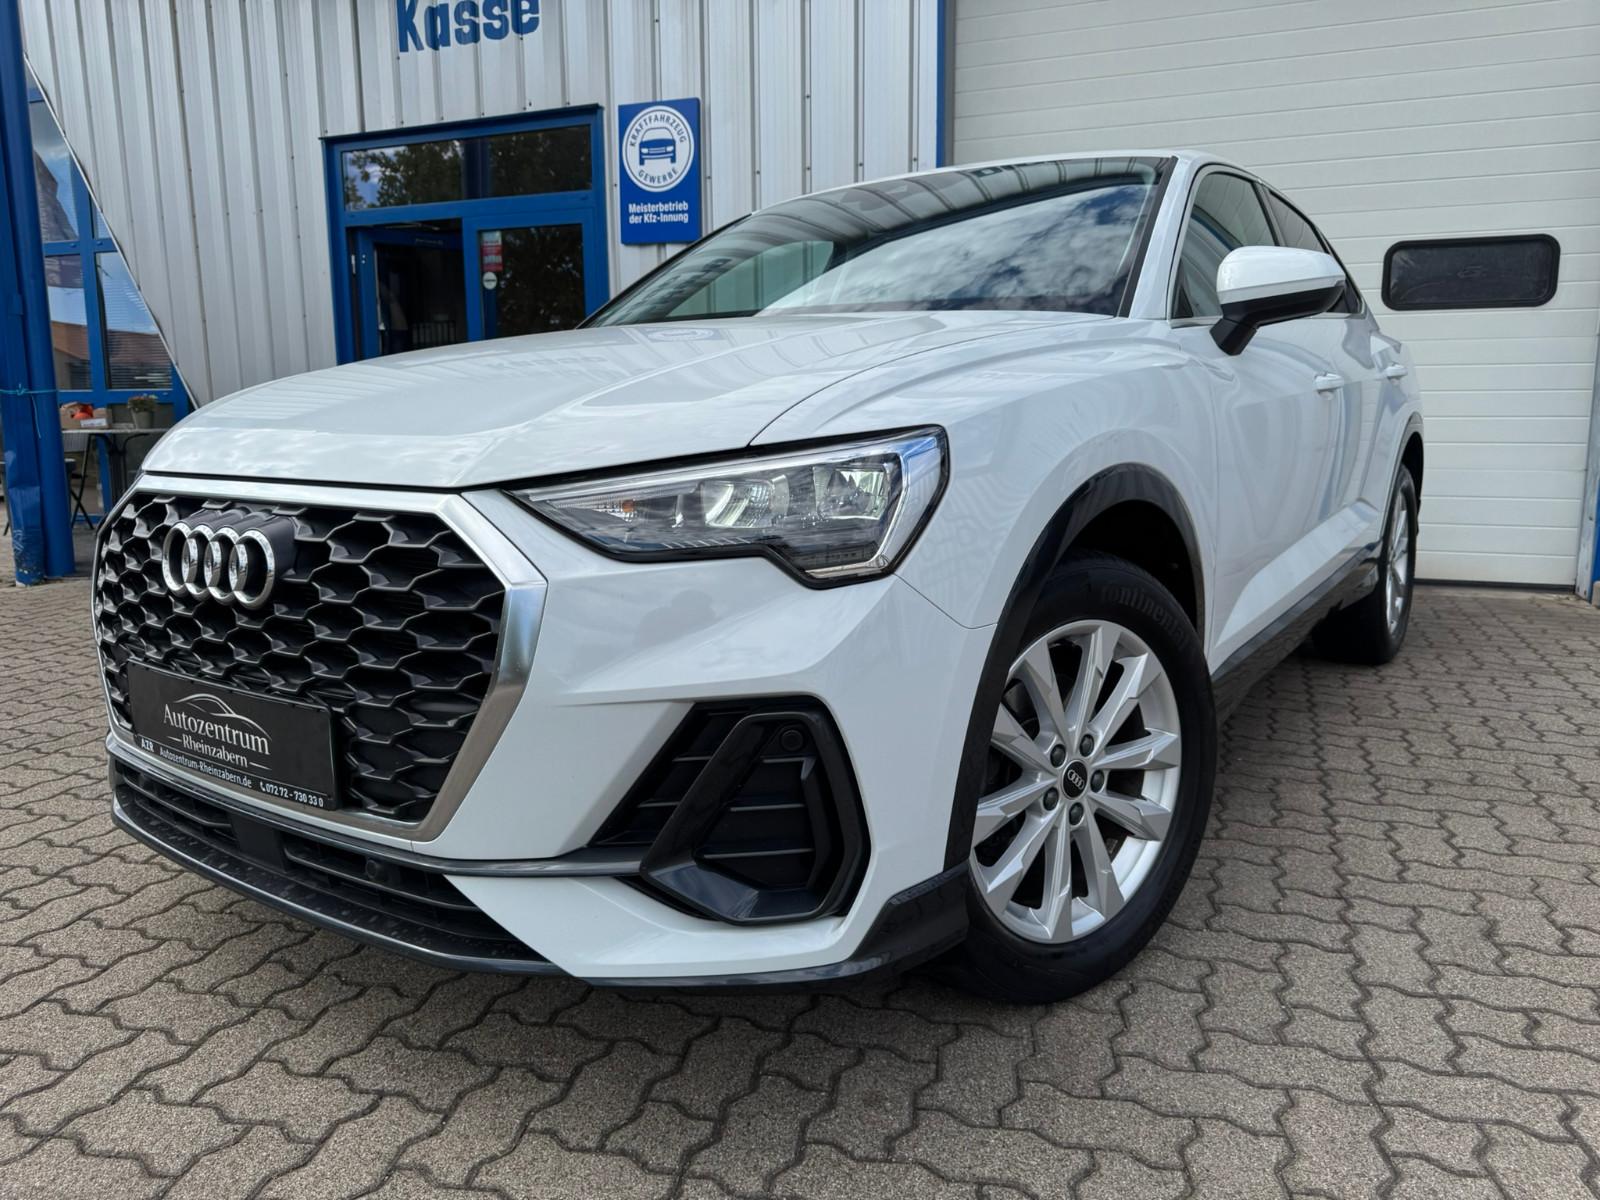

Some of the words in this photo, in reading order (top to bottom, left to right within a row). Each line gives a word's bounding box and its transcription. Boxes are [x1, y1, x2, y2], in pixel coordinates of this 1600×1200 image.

[397, 0, 540, 52] Kasse
[629, 113, 687, 147] KRAFTFAHRZEUG
[638, 166, 679, 185] GEWERBE
[628, 201, 689, 214] Meisterbetrieb
[629, 214, 642, 224] der
[643, 212, 689, 224] Kfz-Innung
[163, 704, 270, 755] Autozentrum
[141, 738, 154, 752] AZR
[160, 746, 252, 788] Autozentrum-Rheinzabern.de
[182, 733, 248, 768] Rheinzabern
